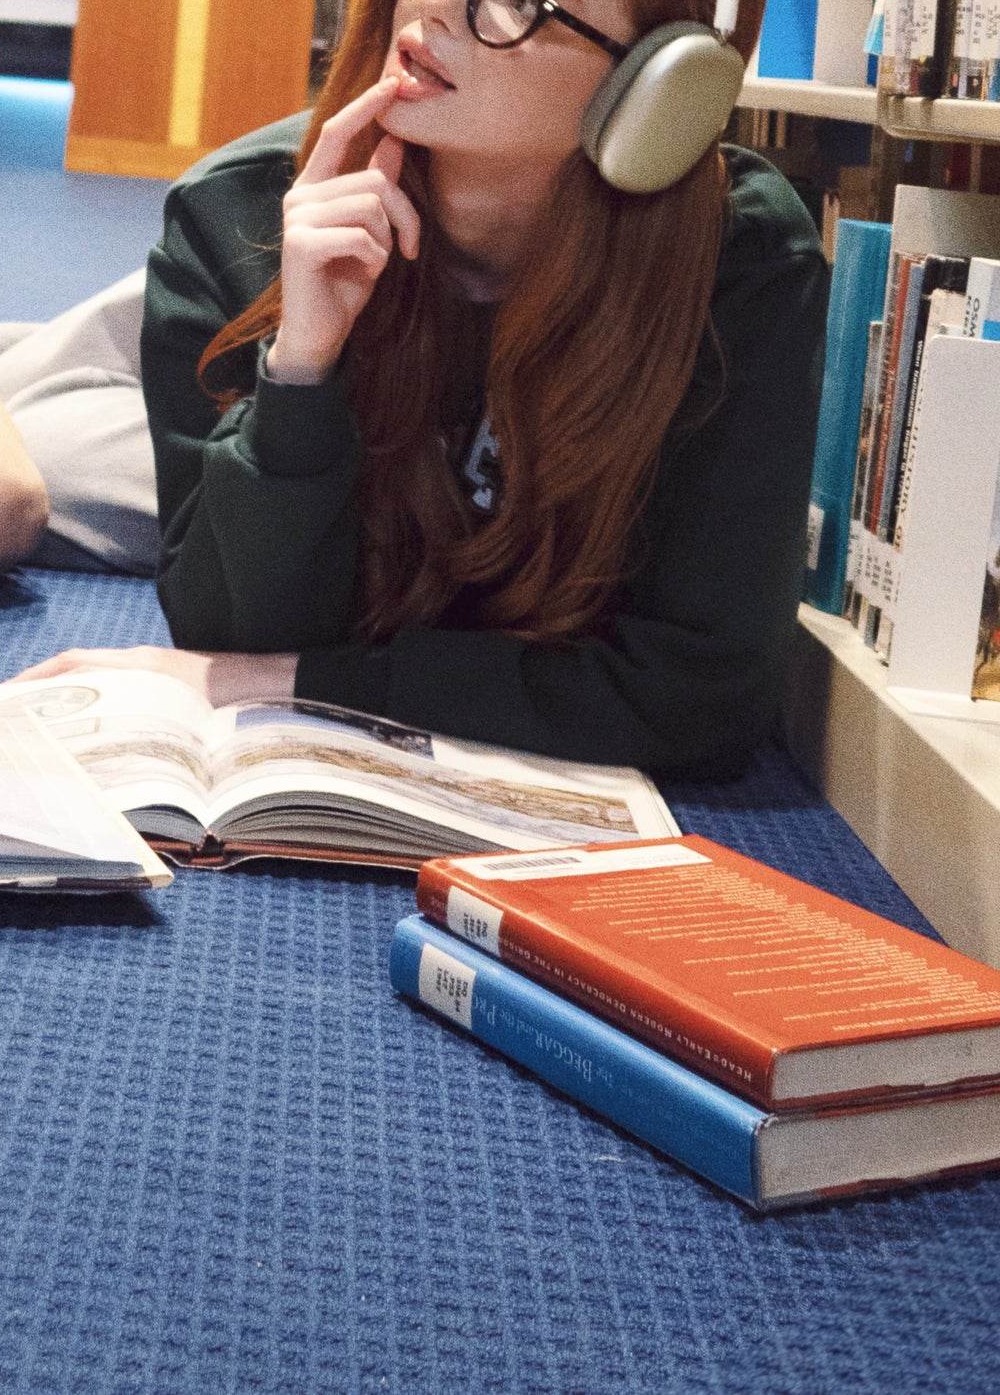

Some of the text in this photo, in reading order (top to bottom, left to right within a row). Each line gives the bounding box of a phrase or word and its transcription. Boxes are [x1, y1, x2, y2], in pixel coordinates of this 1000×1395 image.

[534, 955, 551, 971] THE
[554, 968, 564, 978] IN
[568, 975, 626, 1013] DEMOCRACY
[630, 1009, 672, 1038] MODERN
[535, 1029, 593, 1083] BEGGAR
